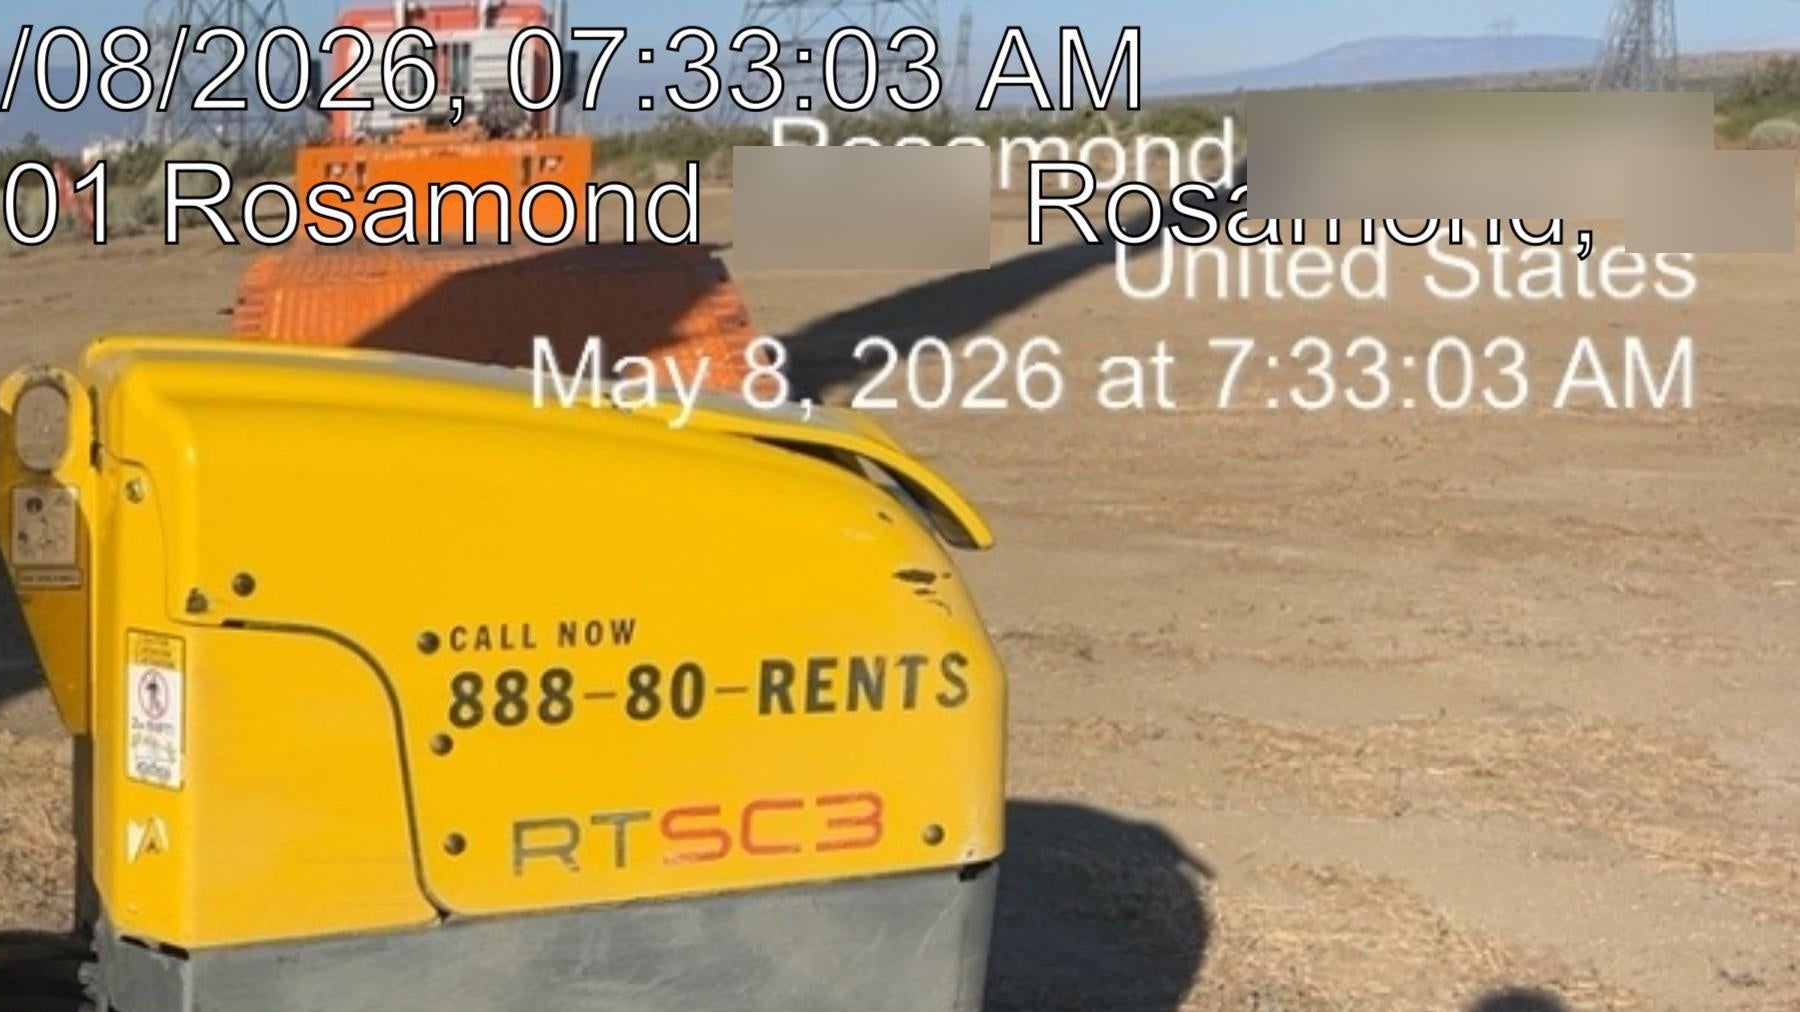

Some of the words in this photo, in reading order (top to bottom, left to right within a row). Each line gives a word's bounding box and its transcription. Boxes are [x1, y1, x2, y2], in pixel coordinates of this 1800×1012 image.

[449, 623, 538, 652] CALL
[557, 617, 638, 647] NOW
[447, 651, 972, 730] 888-80-RENTS
[512, 790, 885, 877] RTSC3
